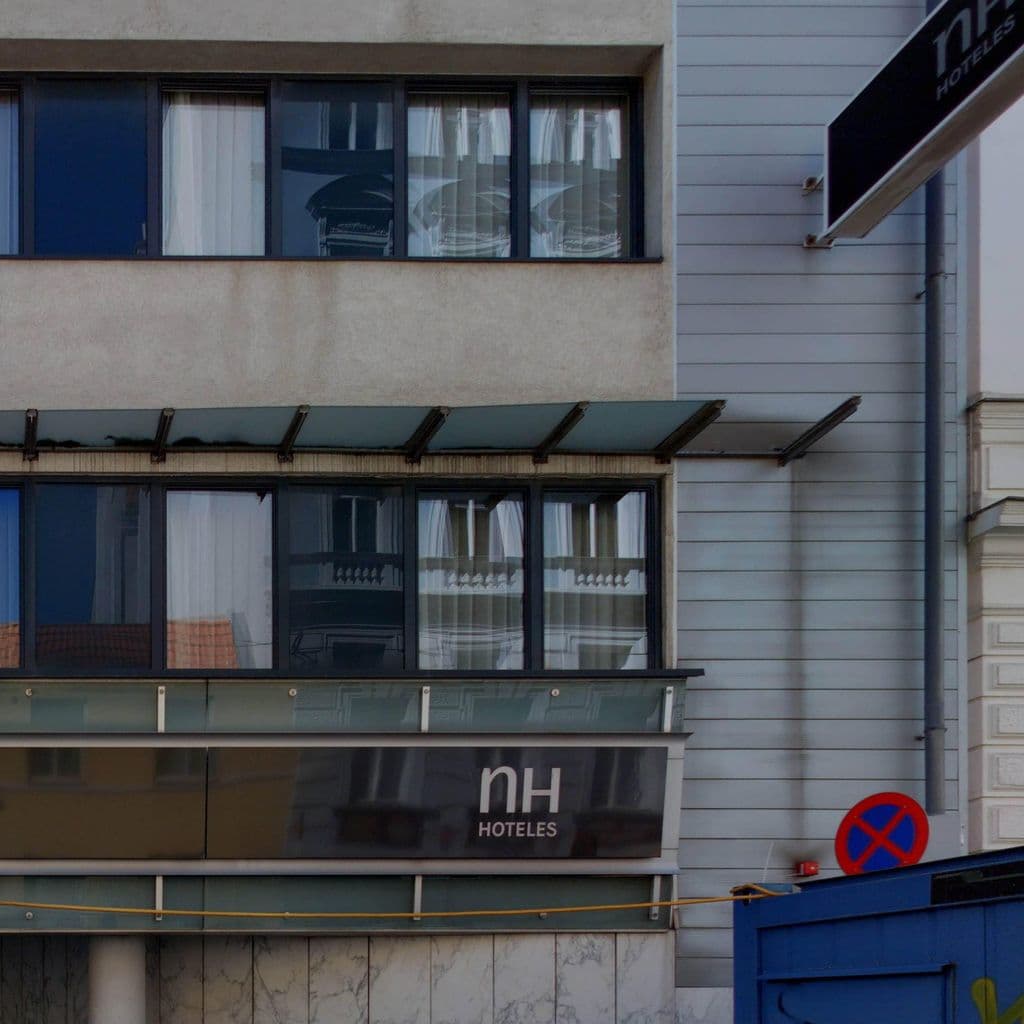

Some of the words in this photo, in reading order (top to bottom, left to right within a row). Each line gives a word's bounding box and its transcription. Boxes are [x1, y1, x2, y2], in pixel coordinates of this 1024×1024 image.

[936, 15, 1015, 101] HOTELES
[479, 765, 561, 813] nH
[479, 821, 557, 837] HOTELES
